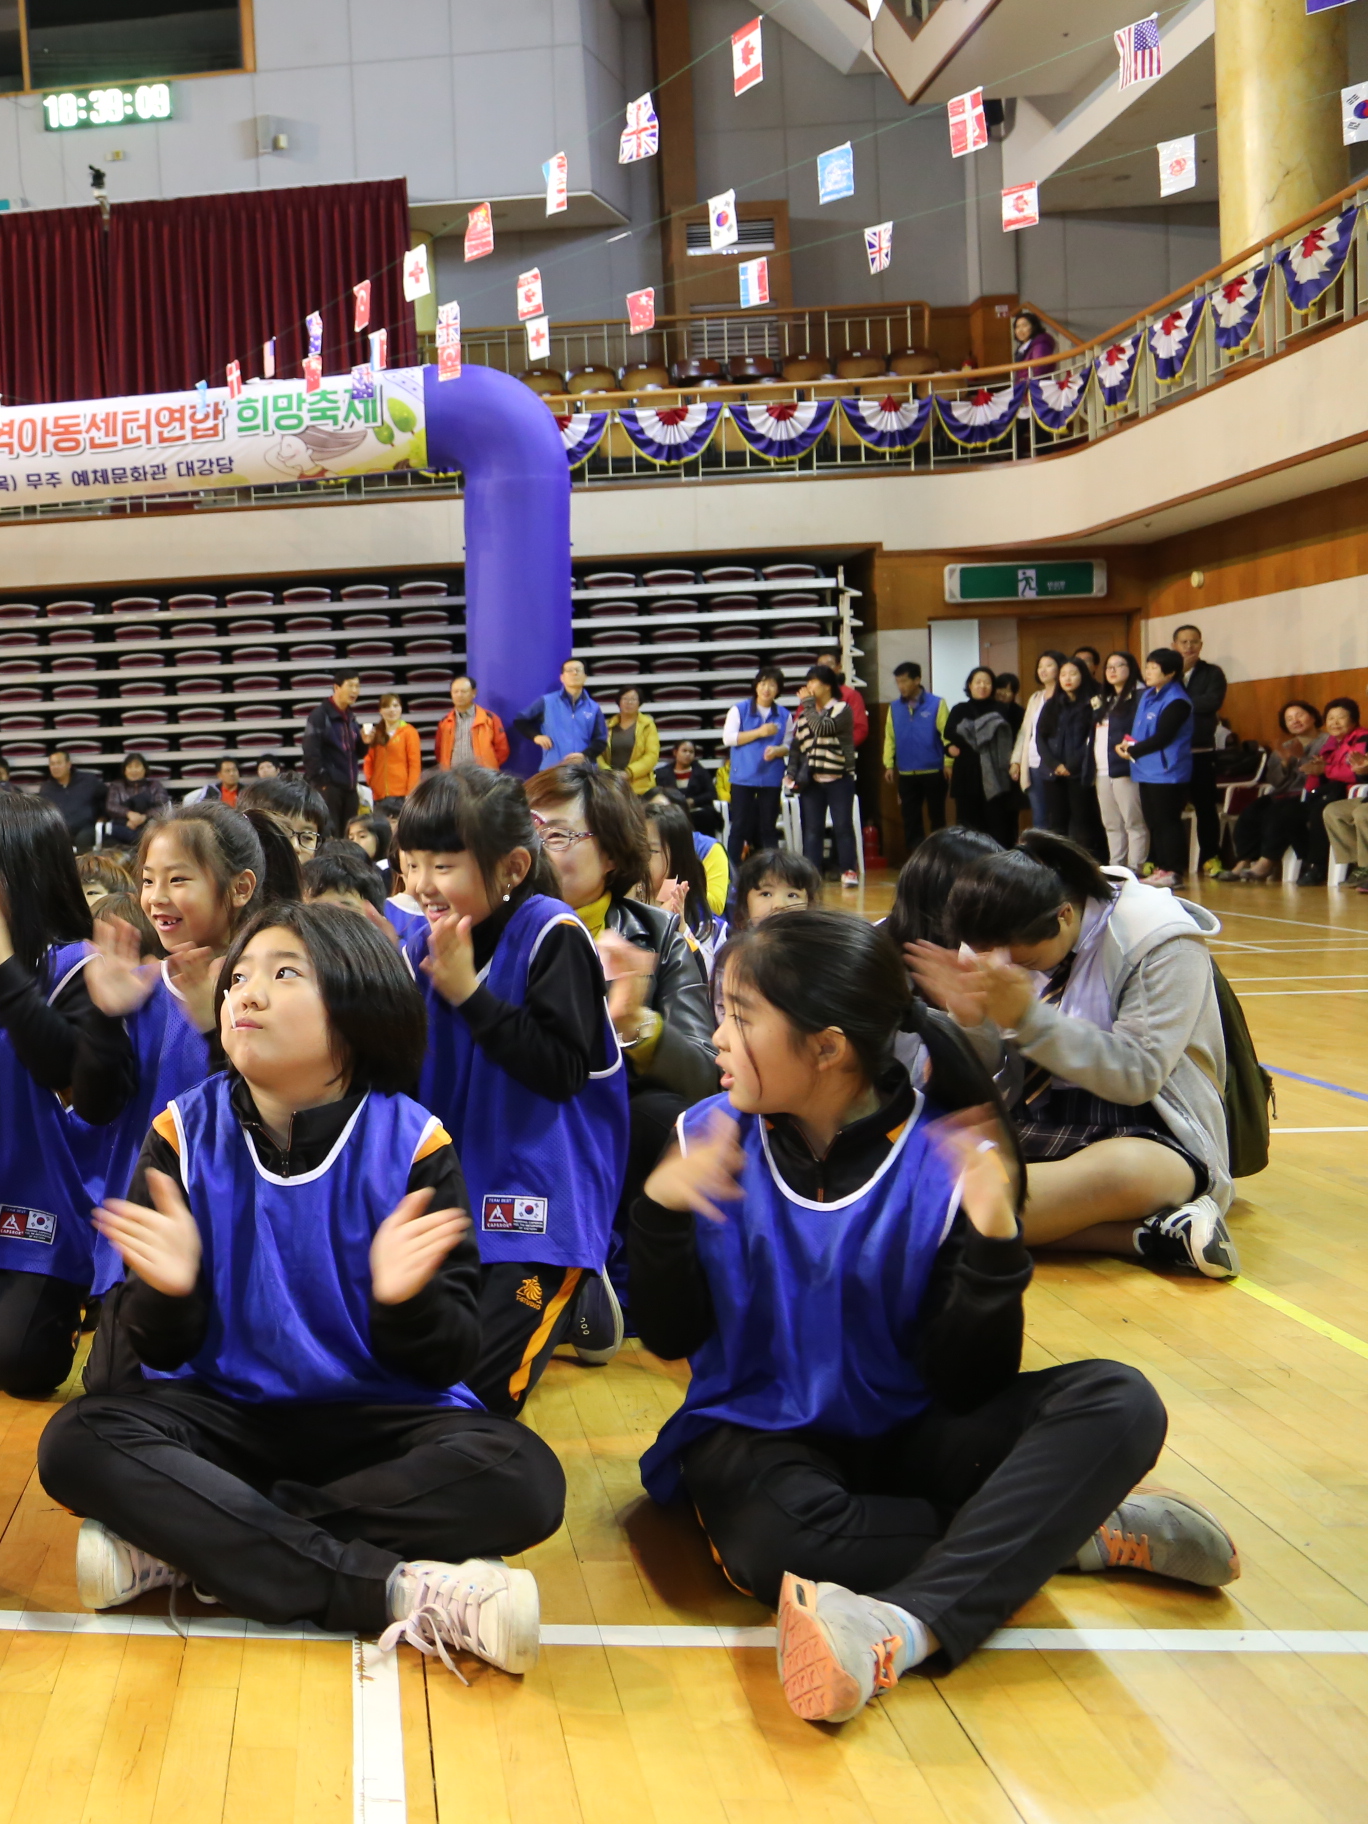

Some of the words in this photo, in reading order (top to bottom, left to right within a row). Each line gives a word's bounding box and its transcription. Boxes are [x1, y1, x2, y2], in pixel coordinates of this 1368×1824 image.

[236, 384, 380, 433] 희망축제
[26, 471, 63, 490] 무주
[71, 463, 168, 487] 예체문화관
[176, 456, 235, 478] 대강당
